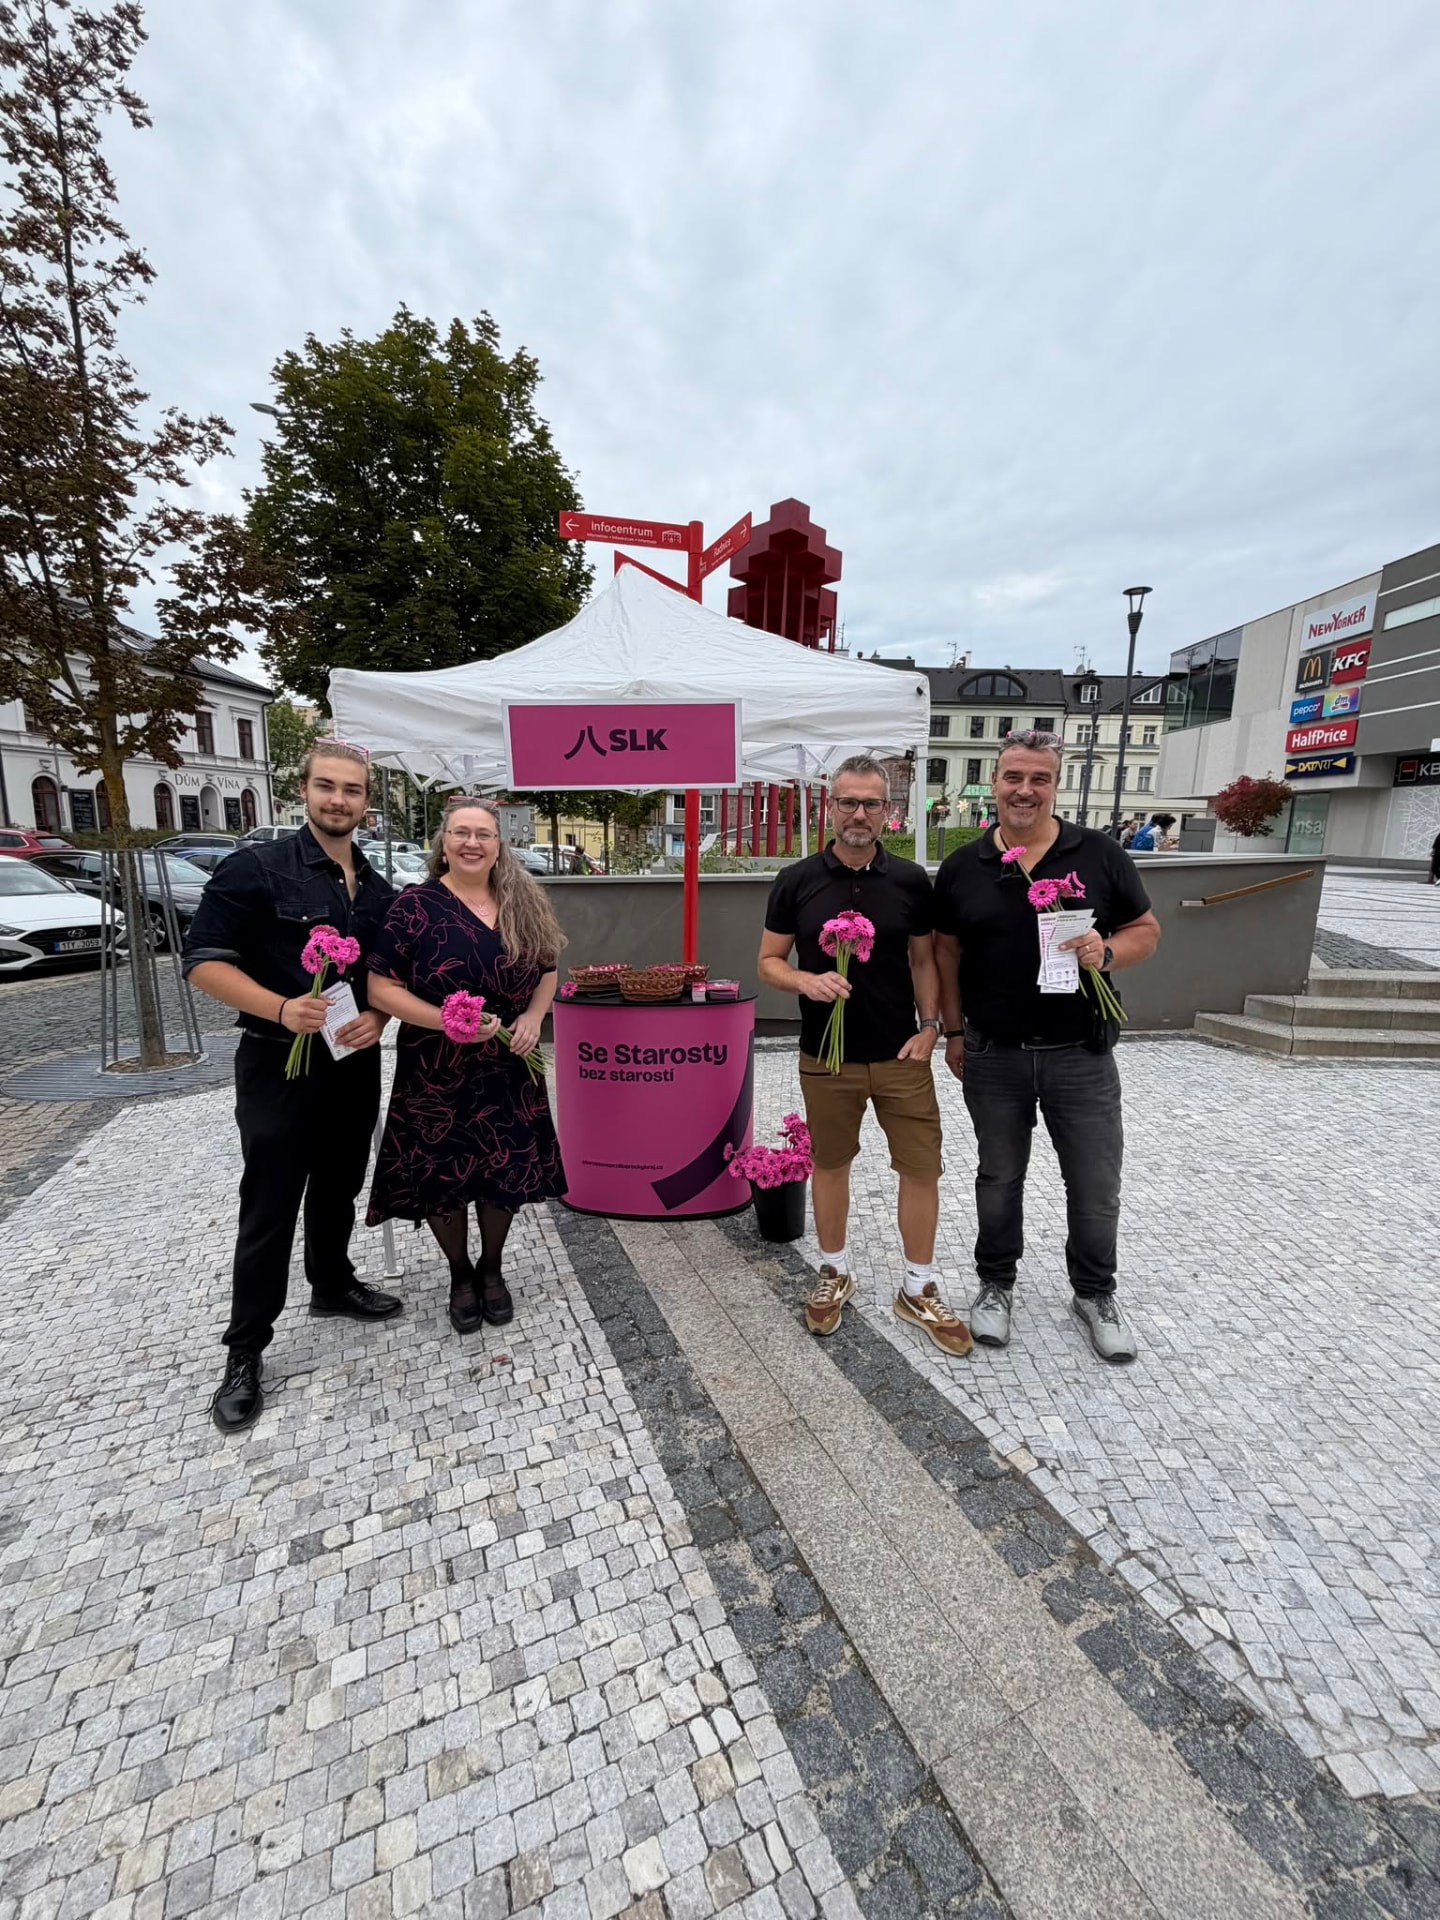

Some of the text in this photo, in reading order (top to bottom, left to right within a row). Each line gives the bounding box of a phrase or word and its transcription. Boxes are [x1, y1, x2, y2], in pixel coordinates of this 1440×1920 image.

[591, 521, 653, 537] Infocentrum
[1331, 650, 1368, 673] KFC
[1334, 694, 1349, 706] dm
[1293, 703, 1318, 717] pepco
[609, 728, 669, 752] SLK
[1291, 728, 1348, 748] HalfPrice
[1297, 758, 1335, 773] DATART
[217, 776, 241, 790] VÍNA
[578, 1041, 728, 1066] Se Starosty
[579, 1065, 674, 1082] bez starostí
